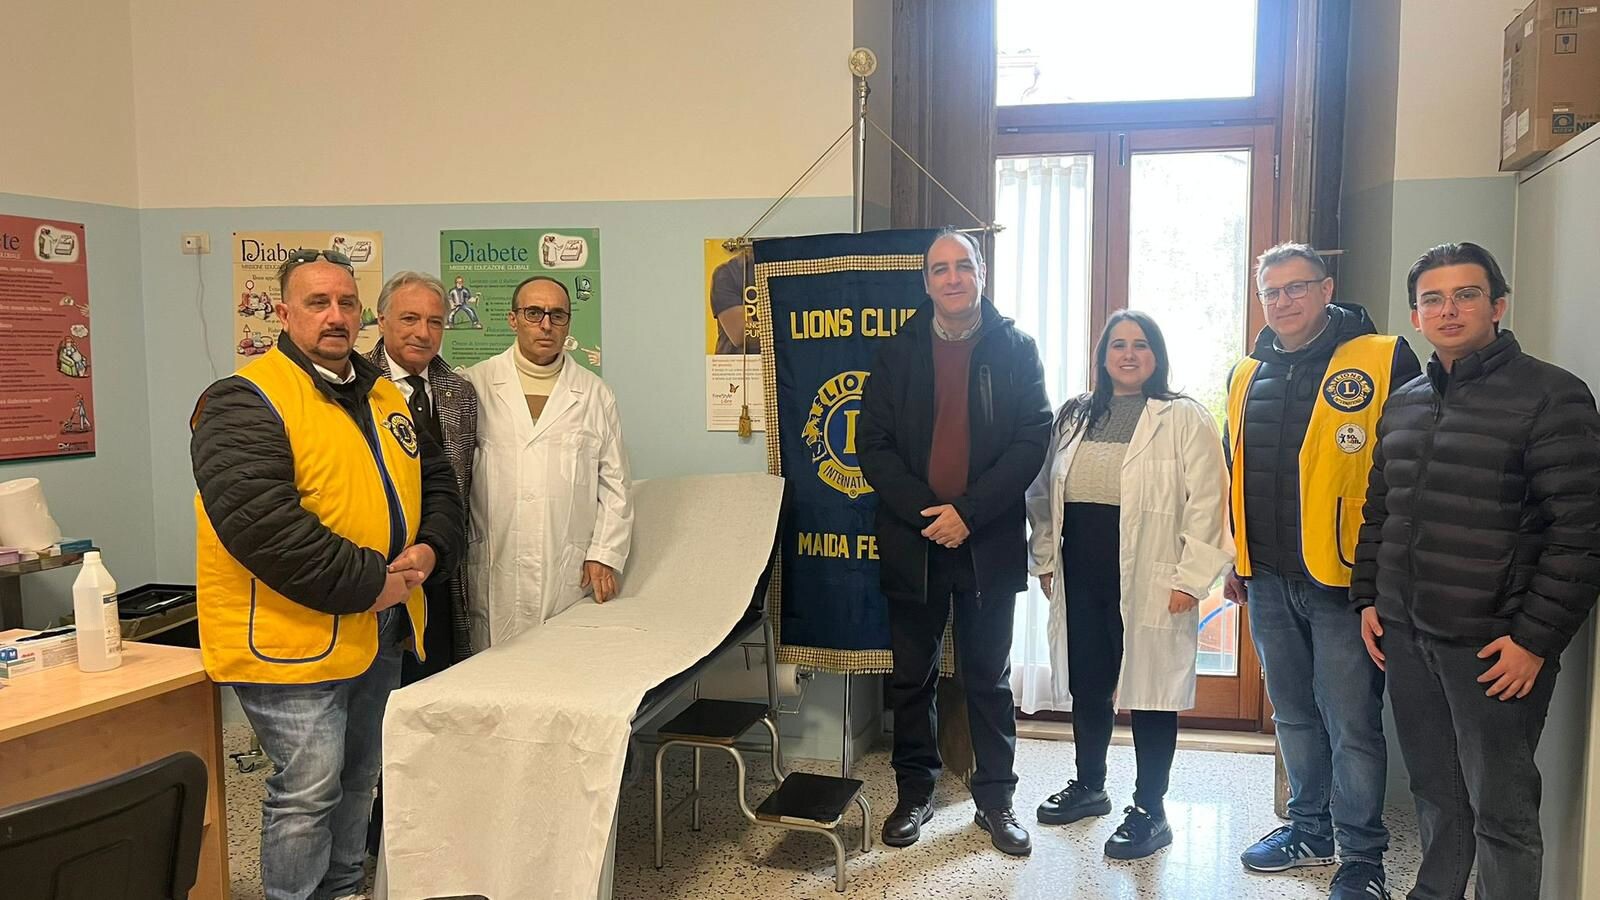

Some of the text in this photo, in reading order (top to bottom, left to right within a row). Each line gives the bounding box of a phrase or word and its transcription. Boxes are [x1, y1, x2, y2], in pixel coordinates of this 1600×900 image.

[0, 233, 20, 251] te
[241, 239, 302, 262] Diabe
[449, 239, 529, 263] Diabete
[790, 307, 917, 339] LIONS CLU
[1336, 373, 1362, 381] LIONS
[1344, 381, 1356, 395] L
[798, 532, 850, 558] MAIDA
